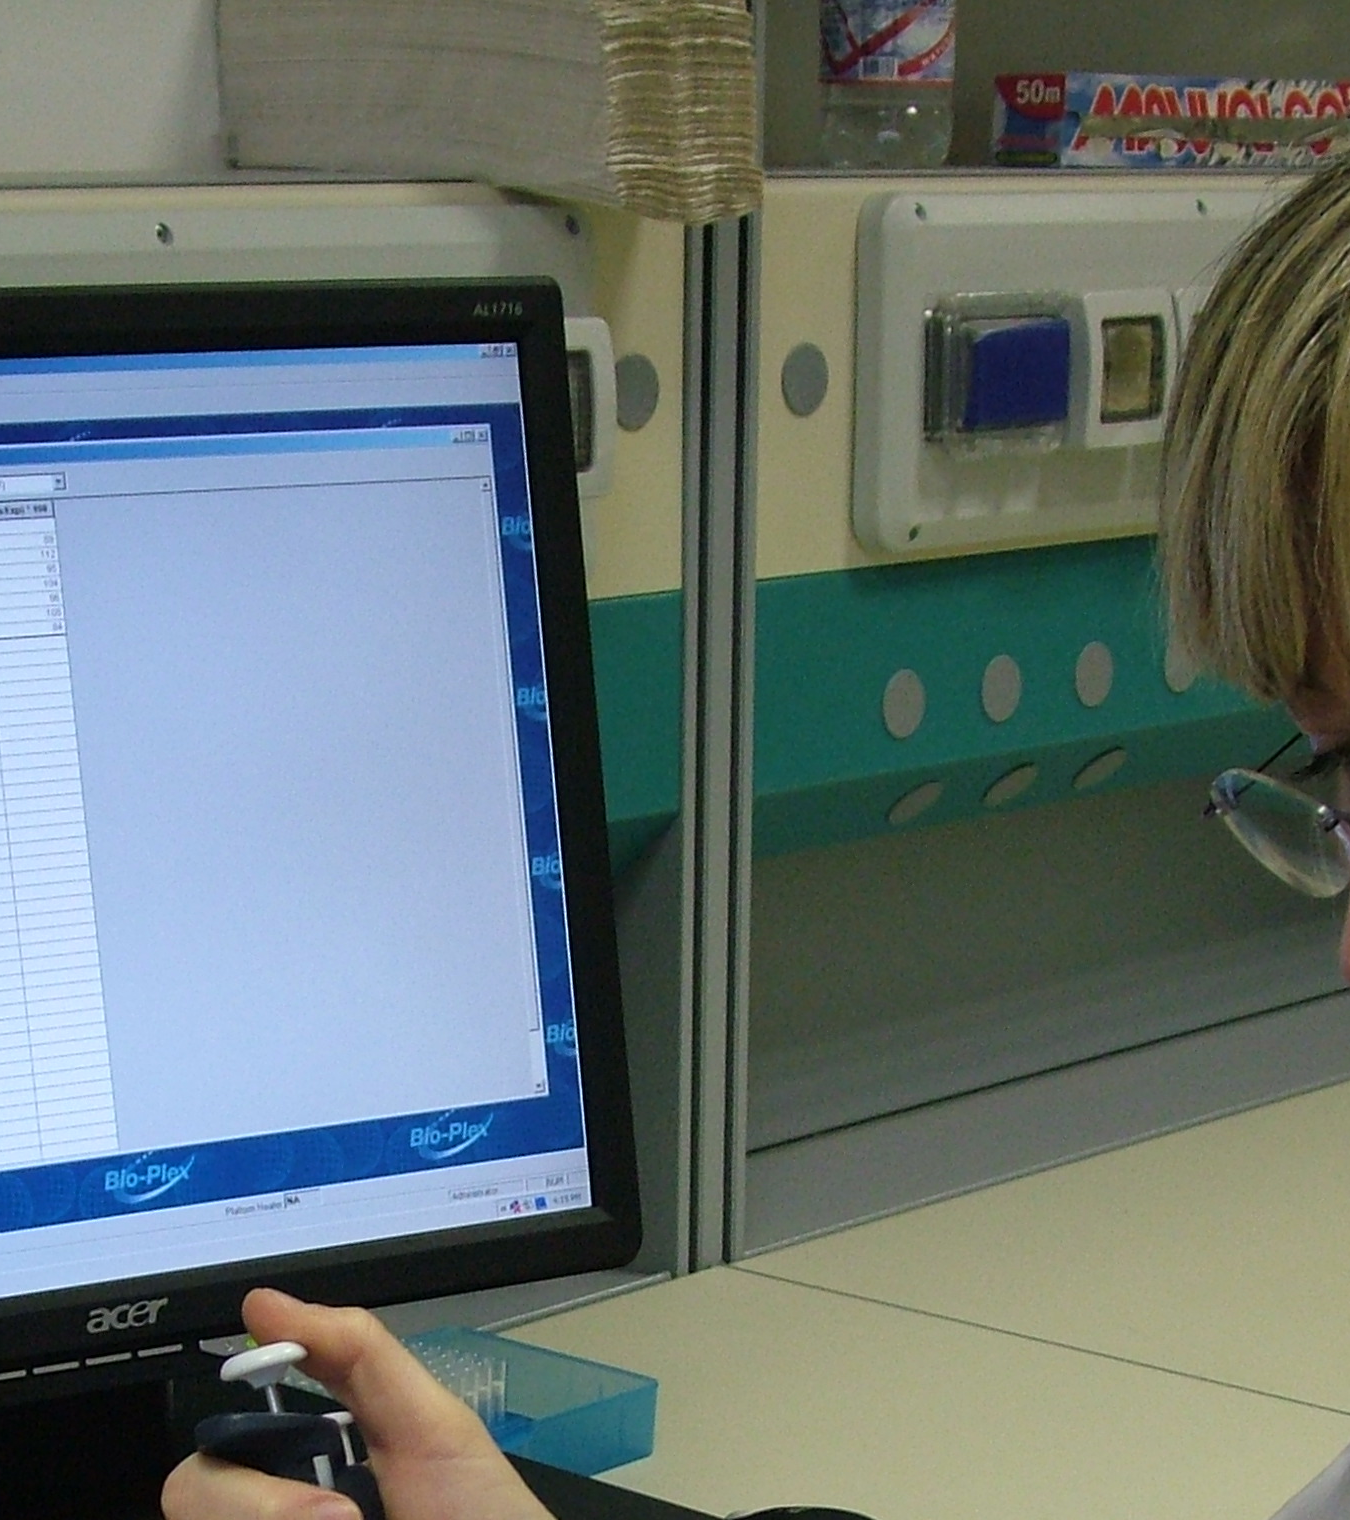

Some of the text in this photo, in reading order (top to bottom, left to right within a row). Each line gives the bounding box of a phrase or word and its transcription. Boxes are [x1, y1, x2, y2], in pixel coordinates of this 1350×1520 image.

[1016, 78, 1061, 105] 50m
[410, 1121, 489, 1149] Bio-Plex
[104, 1159, 191, 1192] Bio-Plex
[86, 1296, 169, 1334] acer
